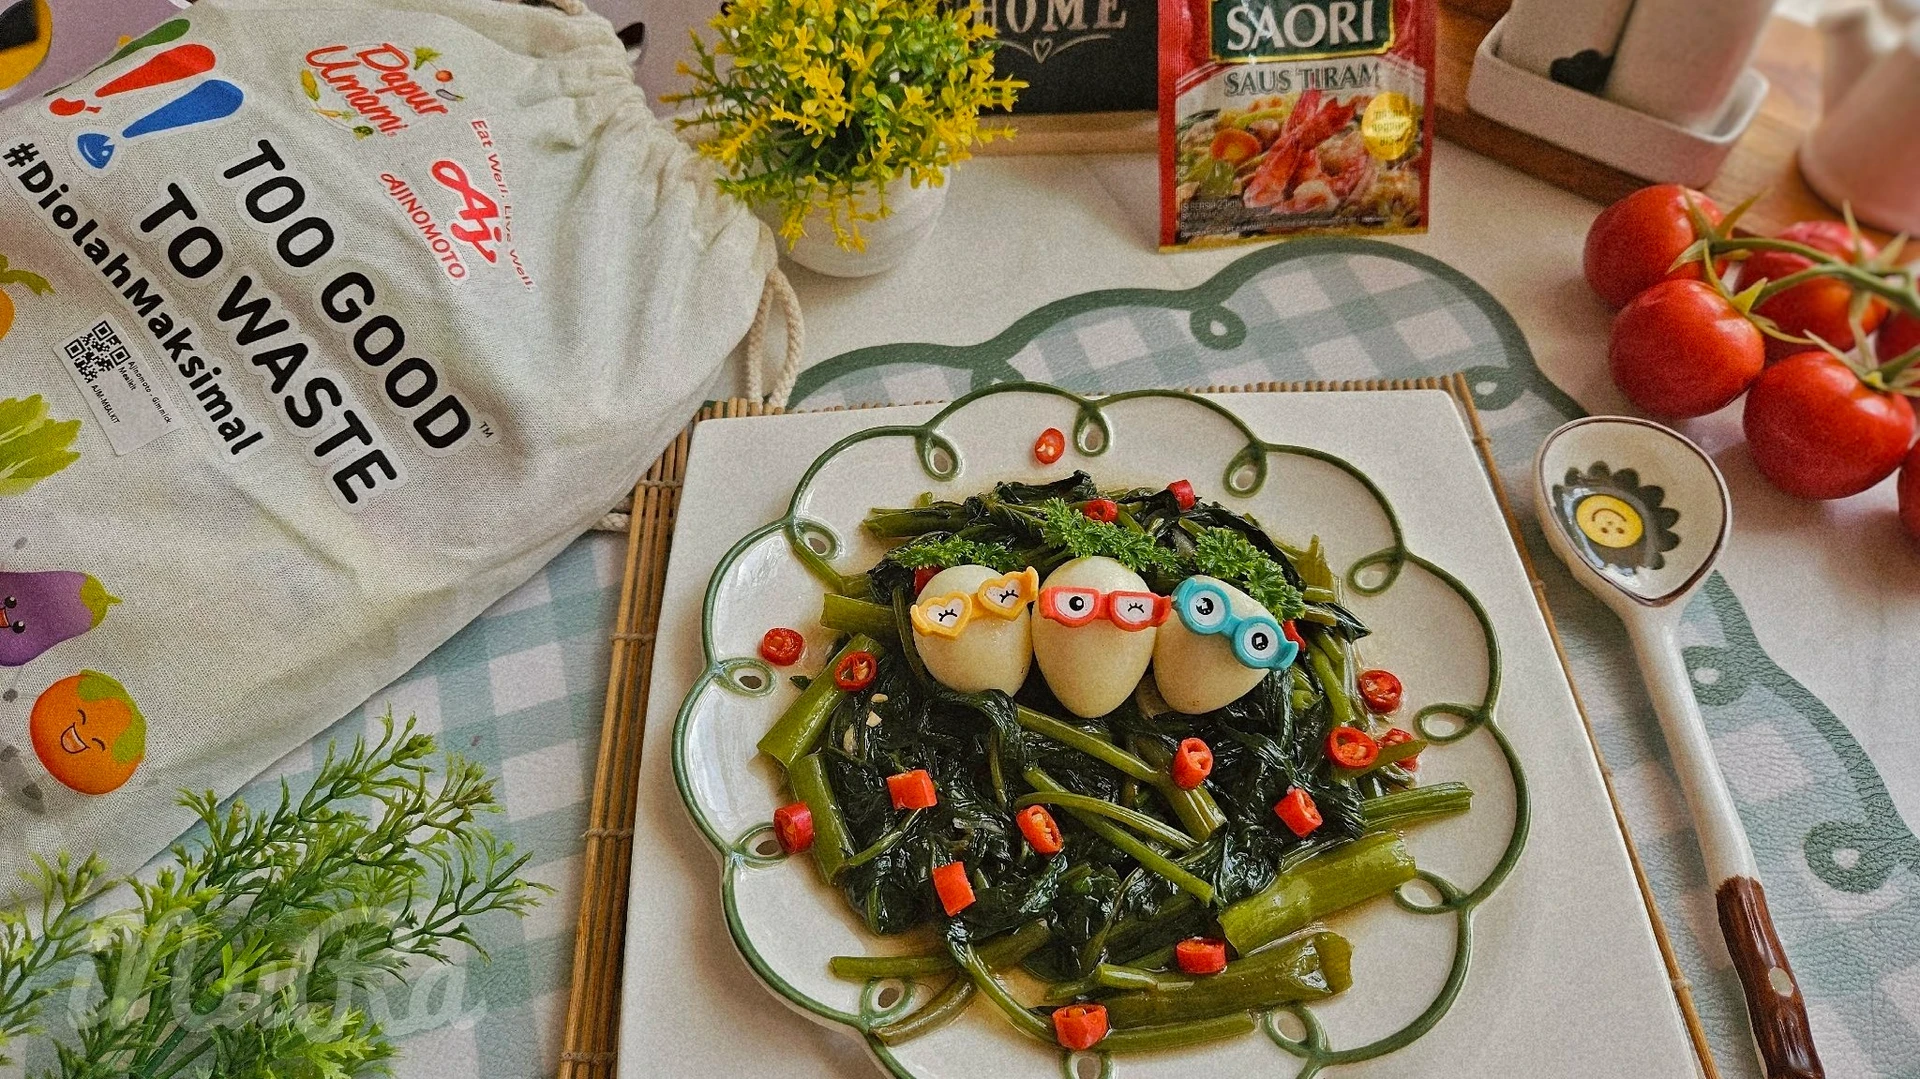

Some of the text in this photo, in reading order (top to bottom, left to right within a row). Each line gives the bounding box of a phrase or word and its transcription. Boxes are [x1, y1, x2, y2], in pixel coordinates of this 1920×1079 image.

[971, 0, 1127, 33] HOME
[1226, 0, 1374, 51] SAORI
[355, 42, 449, 115] Dapur
[1224, 62, 1380, 97] SAUS TIRAM
[471, 119, 493, 148] Eat
[503, 205, 513, 242] Live
[380, 173, 466, 279] AJINOMOTO
[2, 142, 264, 456] #DiolahMaksimal
[222, 138, 472, 450] TOO GOOD
[139, 182, 399, 505] TO WASTE
[128, 361, 152, 393] Ajinomoto
[152, 396, 172, 424] Gimmick
